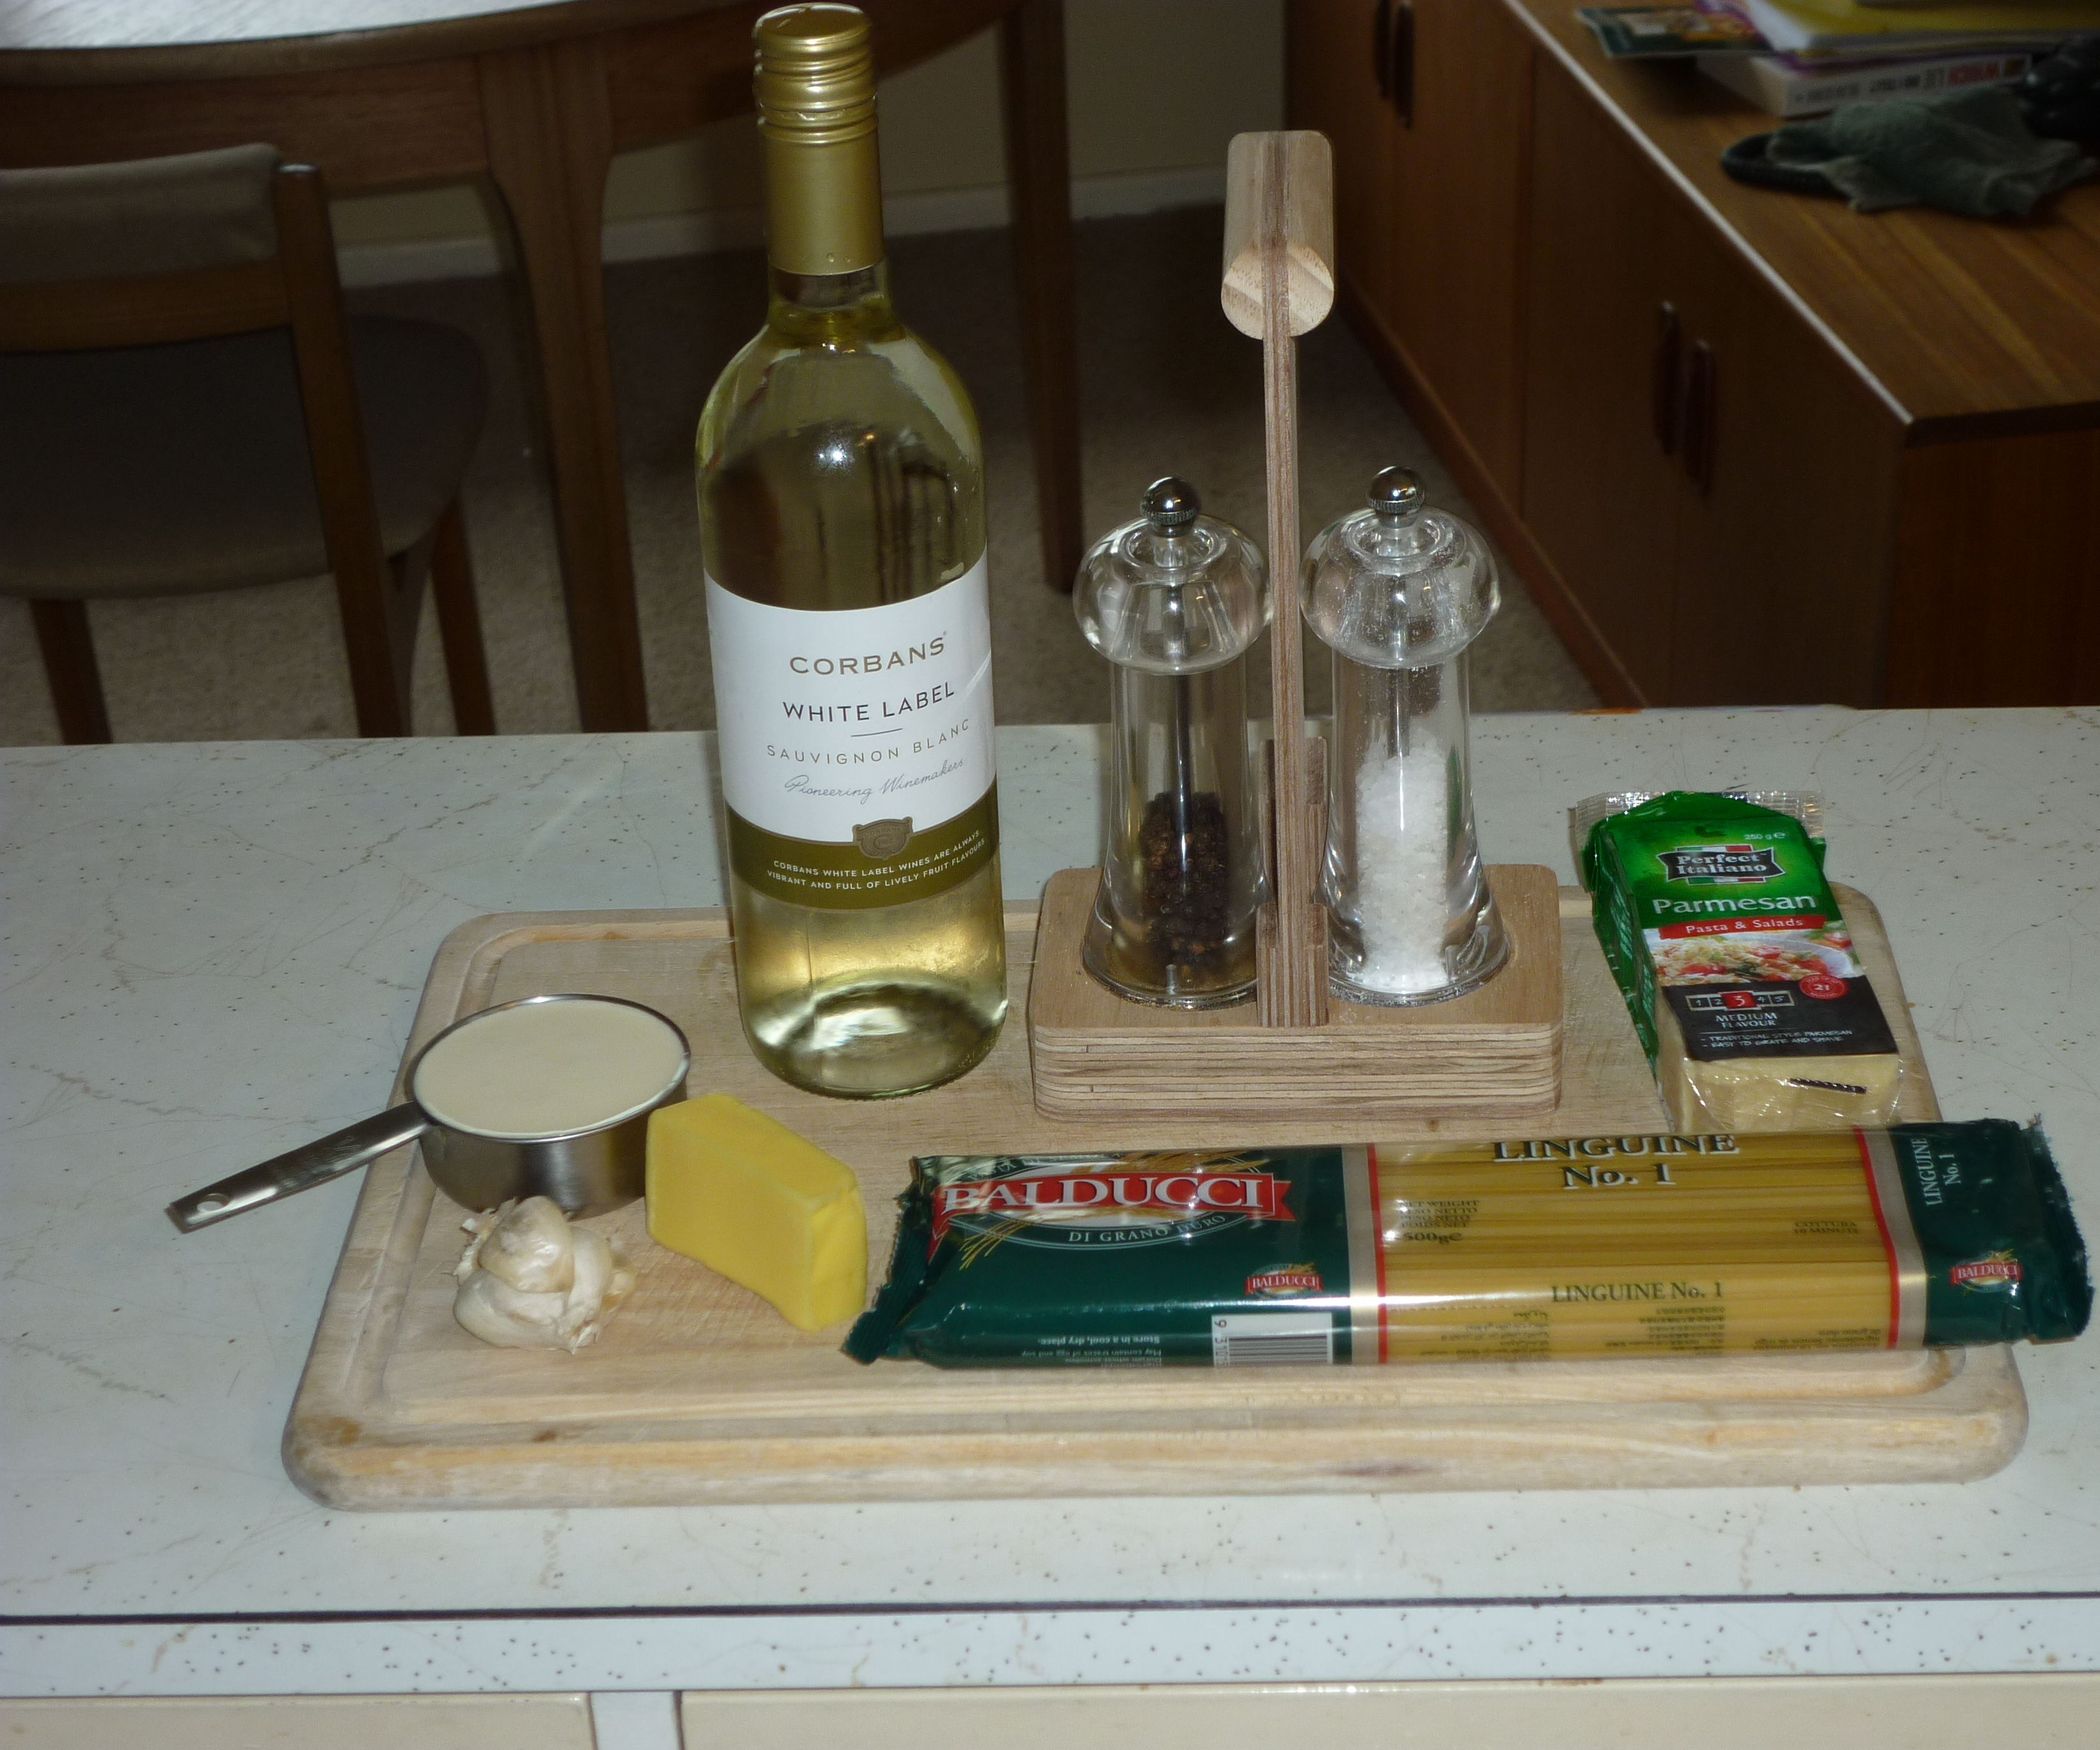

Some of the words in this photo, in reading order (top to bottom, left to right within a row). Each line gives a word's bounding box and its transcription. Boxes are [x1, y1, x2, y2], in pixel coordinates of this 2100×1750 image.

[789, 636, 945, 675] CORBANS
[783, 701, 869, 722] WHITE
[882, 681, 954, 717] LABEL
[767, 744, 898, 764] SAUVIGNON
[913, 719, 969, 753] BLANC
[784, 774, 873, 805] Pioneering
[880, 758, 966, 794] Winemakers
[773, 860, 819, 876] CORBANS
[823, 869, 857, 877] WHITE
[861, 866, 895, 877] LABEL
[898, 856, 930, 871] WINES
[934, 848, 951, 861] ARE
[953, 829, 980, 852] ALWAYS
[1677, 853, 1760, 865] Perfect
[767, 870, 807, 886] VIBRANT
[810, 881, 832, 889] AND
[836, 882, 862, 890] FULL
[866, 880, 881, 889] OF
[884, 873, 919, 887] LIVELY
[923, 862, 949, 878] FRUIT
[951, 838, 985, 867] FLAVOURS
[1677, 863, 1767, 875] Italiano
[1652, 895, 1817, 914] Parmesan
[1686, 924, 1729, 934] Pasta
[1734, 920, 1747, 929] &
[1752, 918, 1804, 928] Salads
[1733, 995, 1746, 1007] 3
[1715, 1012, 1778, 1023] MEDIUM
[1721, 1020, 1777, 1029] FLAVOUR
[1492, 1134, 1741, 1163] LINGUINE
[1560, 1164, 1639, 1190] No.
[1653, 1162, 1677, 1186] 1
[1911, 1137, 1943, 1206] LINGUINE
[1943, 1162, 1962, 1186] No.
[941, 1176, 1265, 1214] BALDUCCI
[1427, 1199, 1480, 1207] WEIGHT
[1068, 1230, 1091, 1242] DI
[1099, 1226, 1168, 1242] GRANO
[1176, 1214, 1227, 1234] DURO
[1252, 1275, 1317, 1289] BALDUCCI
[1551, 1282, 1666, 1302] LINGUINE
[1671, 1281, 1705, 1298] No.
[1713, 1281, 1723, 1298] 1
[1037, 1336, 1067, 1346] place.
[1068, 1336, 1085, 1346] dry
[1087, 1336, 1111, 1346] cool,
[1121, 1335, 1131, 1344] in
[1133, 1335, 1161, 1344] Store
